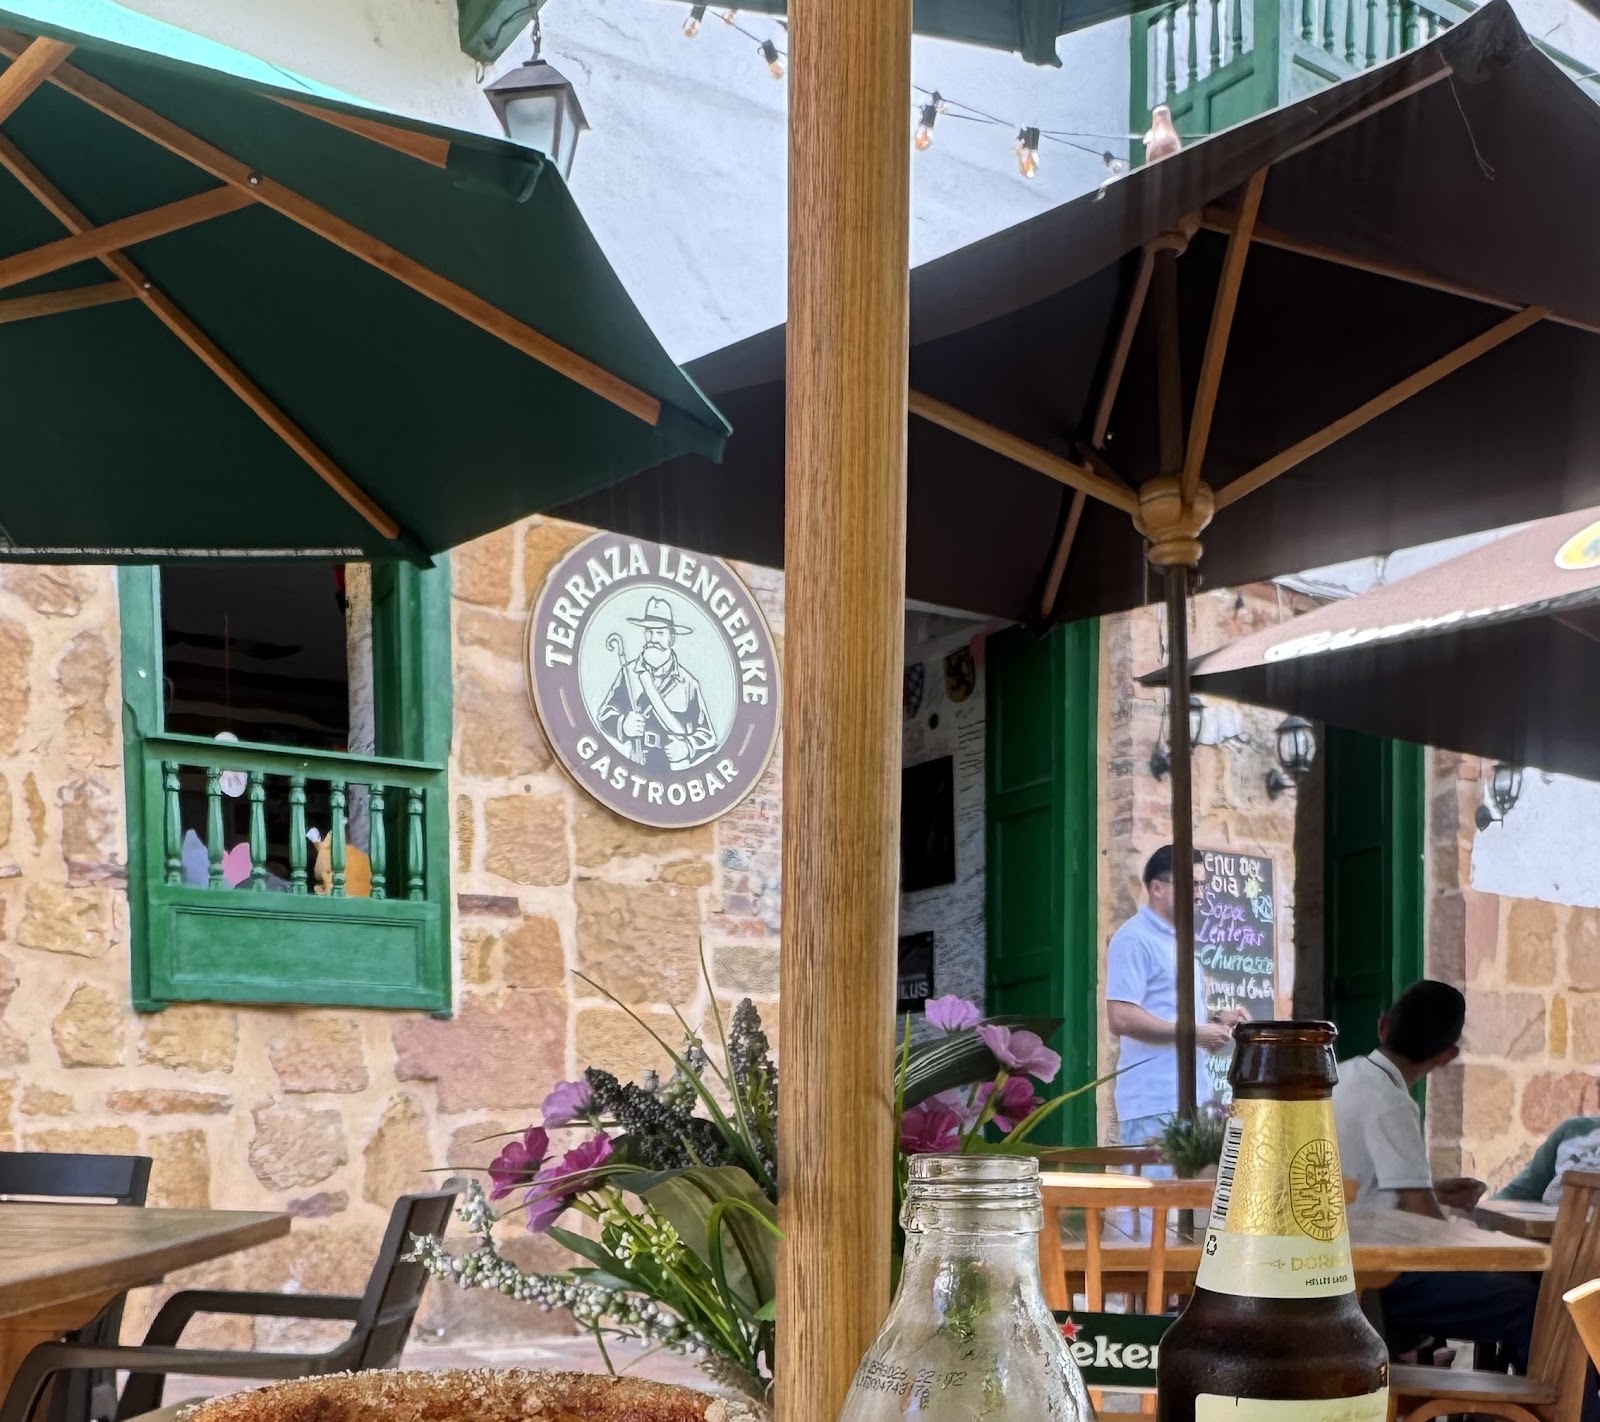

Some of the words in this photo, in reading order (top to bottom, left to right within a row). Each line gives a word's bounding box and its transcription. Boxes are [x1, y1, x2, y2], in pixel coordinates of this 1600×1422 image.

[545, 543, 650, 669] TERRAZA
[658, 544, 770, 706] LENGERKE
[576, 736, 740, 806] GASTROBAR
